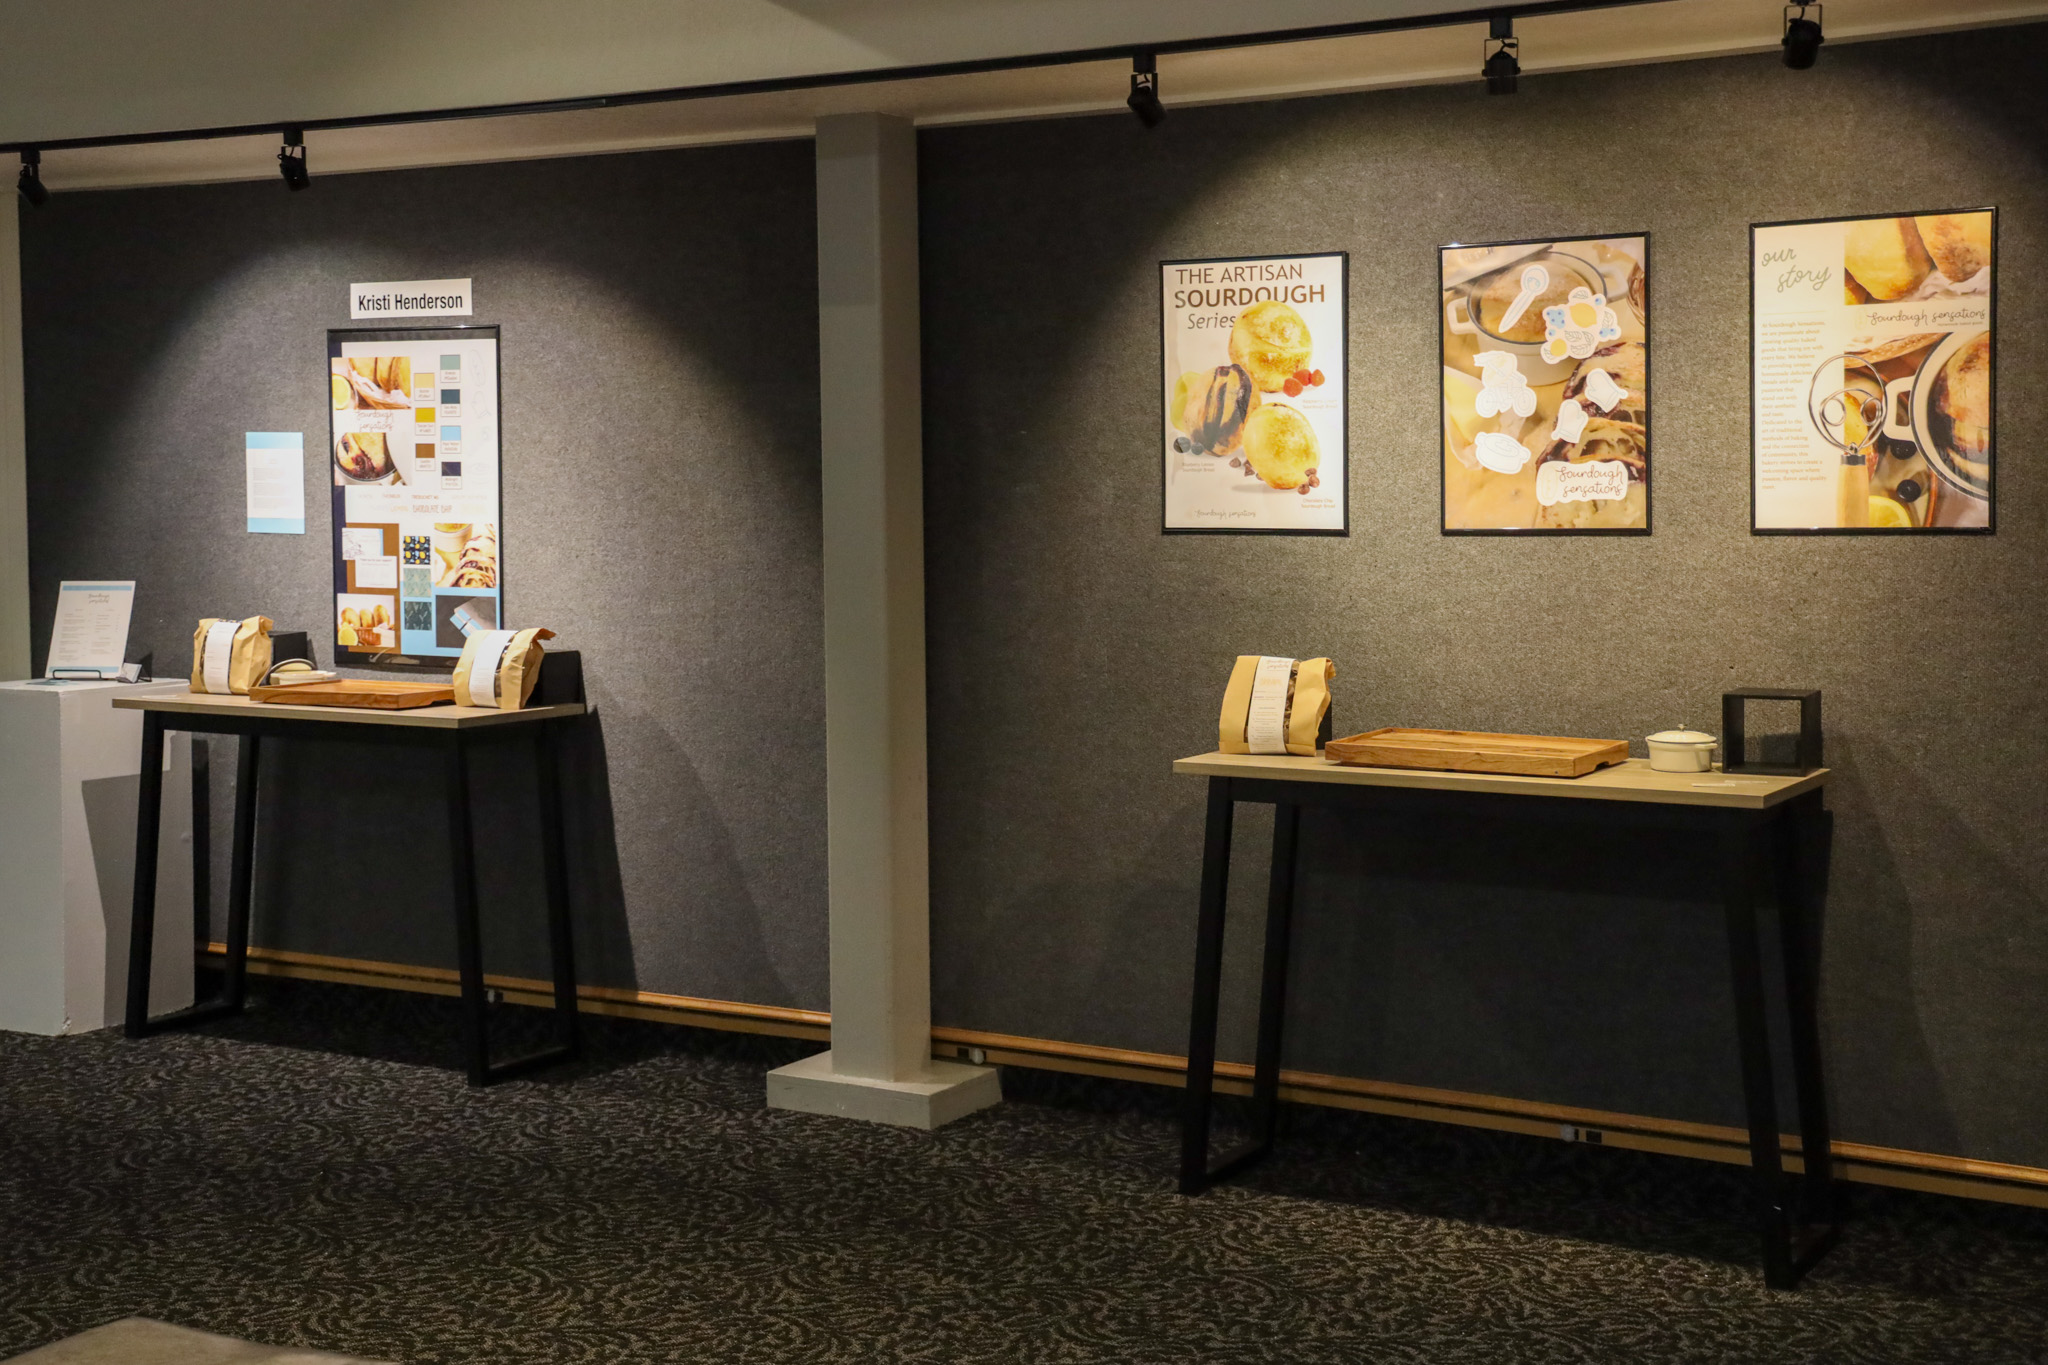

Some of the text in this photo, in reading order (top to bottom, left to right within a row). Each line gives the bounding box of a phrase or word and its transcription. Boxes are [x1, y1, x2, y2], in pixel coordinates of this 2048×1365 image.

[1761, 248, 1797, 267] our
[1175, 263, 1303, 285] THE ARTISAN
[1777, 264, 1832, 293] story
[358, 293, 463, 312] Kristi Henderson
[1174, 284, 1325, 309] SOURDOUGH
[1187, 312, 1236, 330] Series
[1555, 464, 1623, 485] Sourdough
[1562, 482, 1622, 498] sensations
